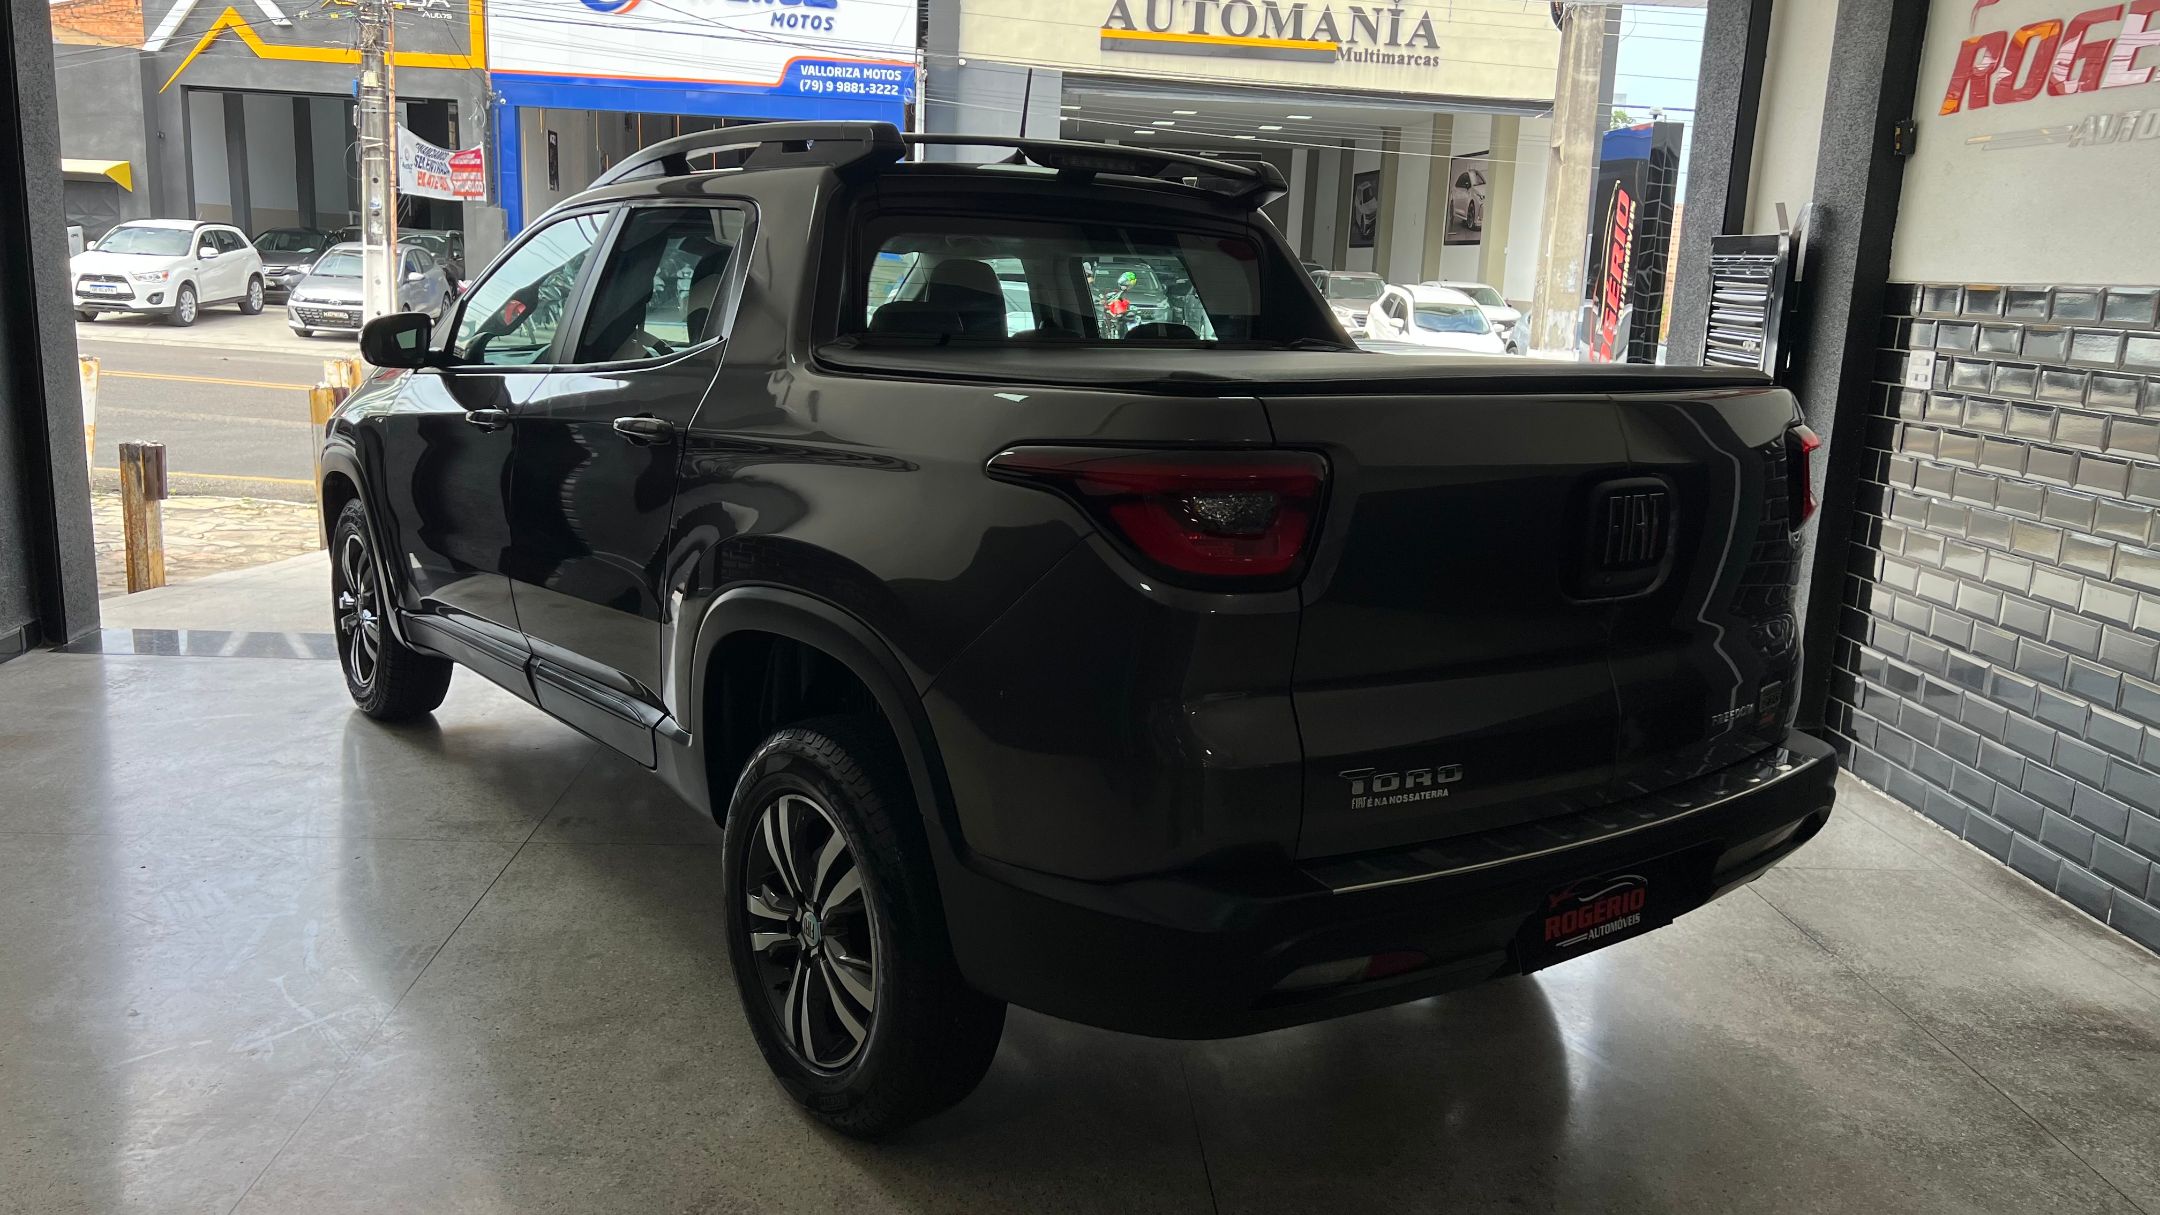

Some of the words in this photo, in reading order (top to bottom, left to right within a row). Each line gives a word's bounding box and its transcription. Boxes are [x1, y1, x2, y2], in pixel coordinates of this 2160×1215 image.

[770, 12, 834, 31] MOTOS
[1336, 47, 1440, 67] Multimarcas
[800, 64, 860, 78] VALLORIZA
[864, 68, 902, 80] MOTOS
[800, 79, 823, 93] (79)
[826, 80, 834, 92] 9
[836, 82, 899, 95] 9881-3222
[1604, 492, 1665, 565] FIAT
[1338, 763, 1464, 795] TORO
[1587, 913, 1641, 941] AUTOMÓVEIS
